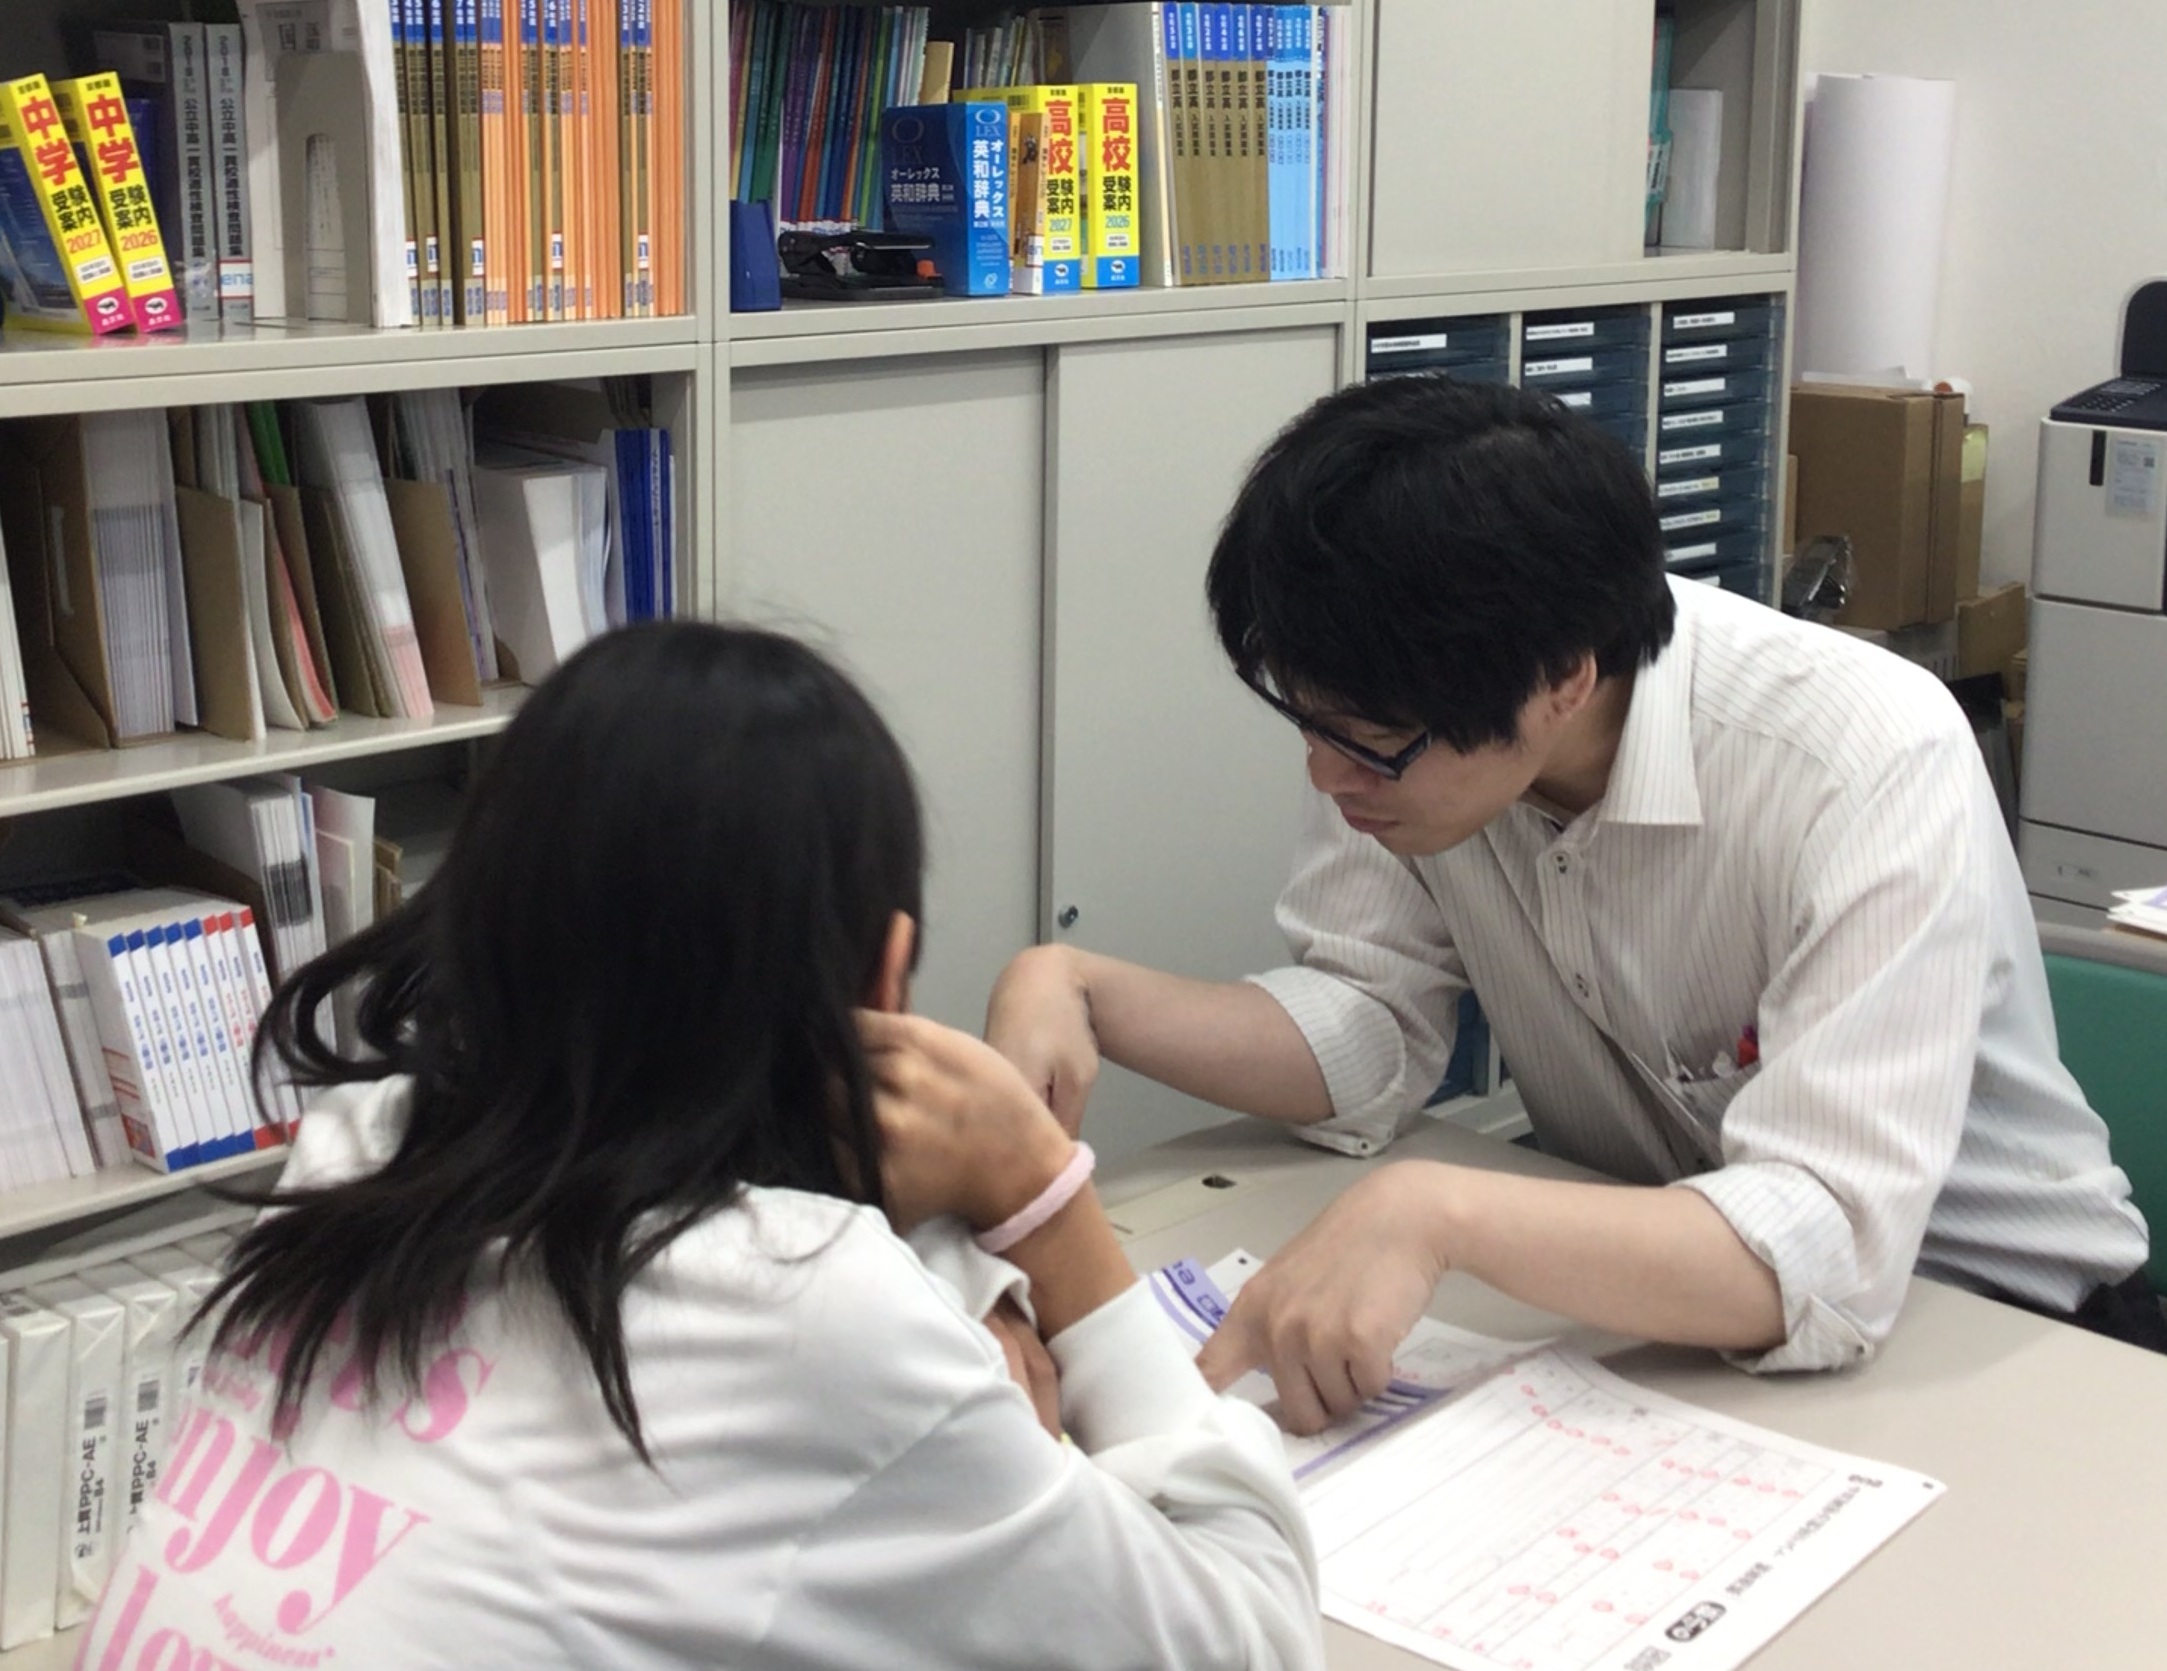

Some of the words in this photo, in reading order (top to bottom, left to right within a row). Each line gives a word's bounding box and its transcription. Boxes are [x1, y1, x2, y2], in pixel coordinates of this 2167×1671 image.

[20, 96, 77, 186] 中学
[86, 93, 140, 184] 中学
[1045, 99, 1074, 175] 高校
[1101, 97, 1131, 172] 高校
[891, 167, 940, 180] オーレックス
[891, 183, 940, 203] 英和辞典
[973, 139, 990, 219] 英和辞典
[991, 139, 1005, 218] オーレックス
[66, 229, 101, 254] 2027
[121, 229, 158, 252] 2026
[1105, 215, 1130, 229] 2026
[155, 1405, 431, 1635] njoy
